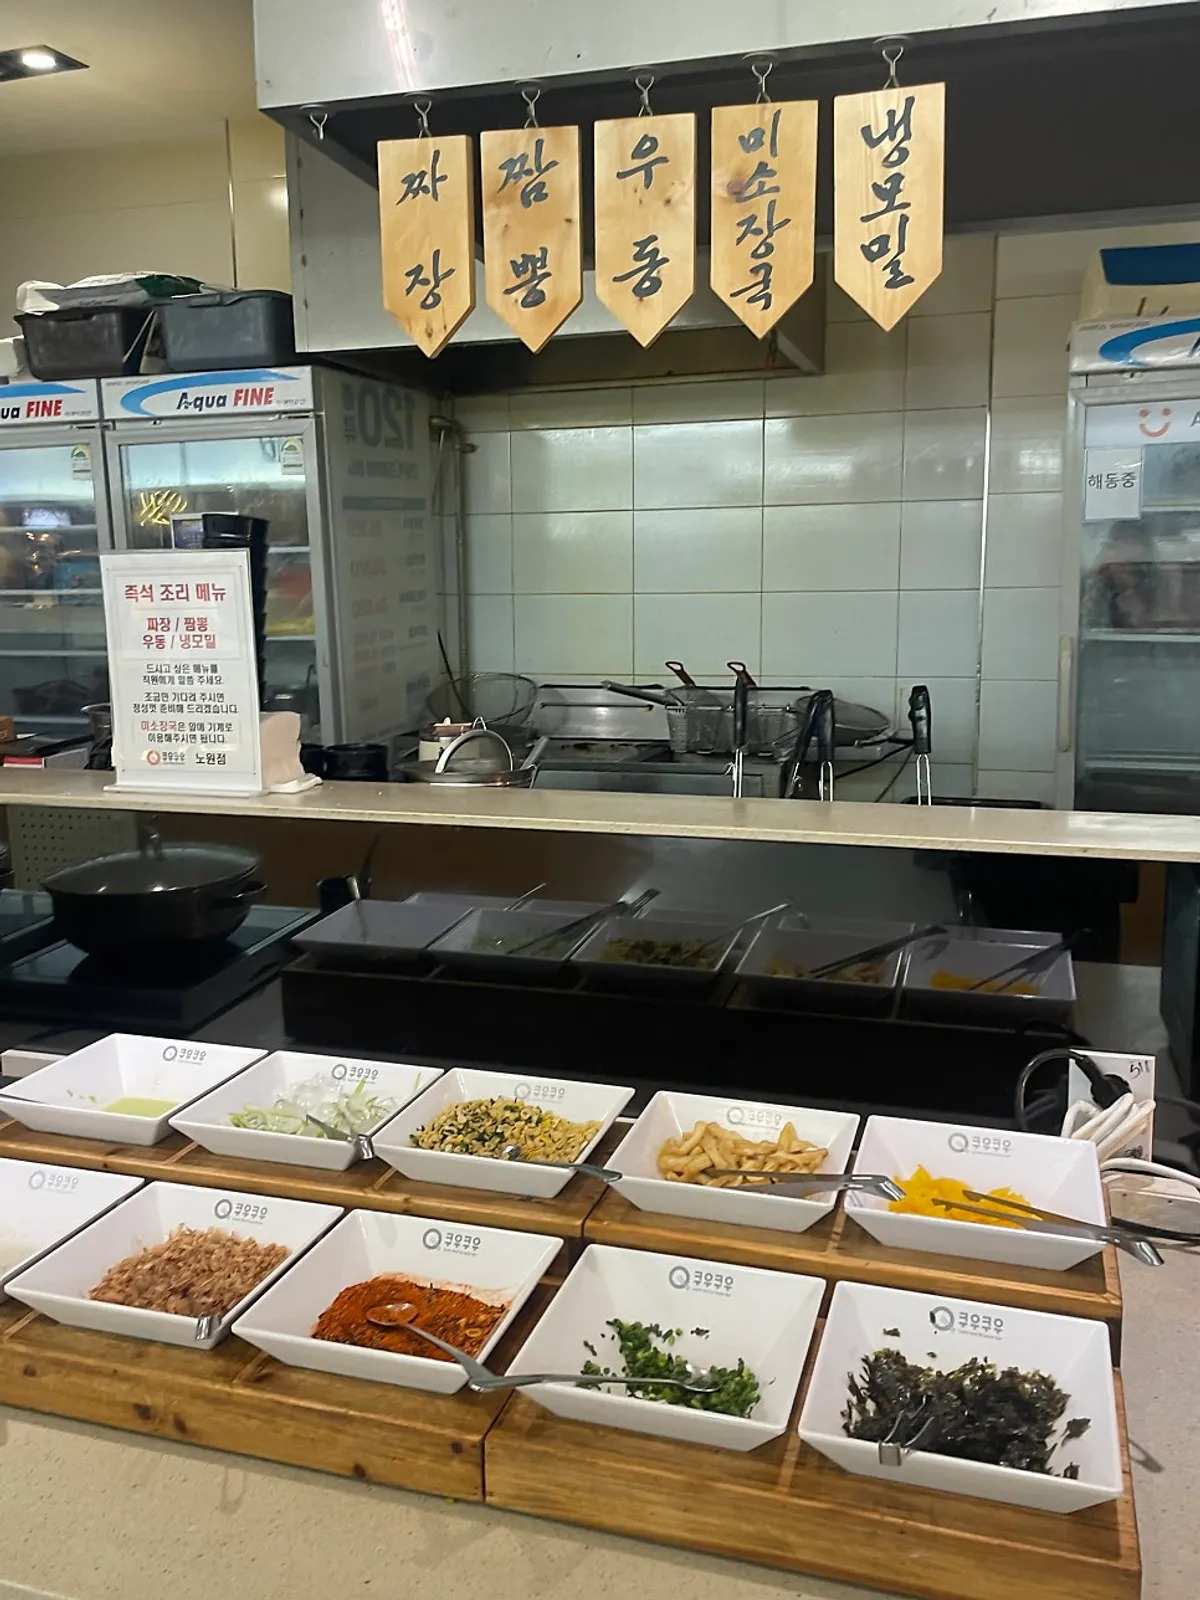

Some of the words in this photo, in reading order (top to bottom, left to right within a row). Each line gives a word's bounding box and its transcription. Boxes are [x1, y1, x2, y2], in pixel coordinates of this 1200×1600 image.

[860, 96, 915, 290] 냉모밀
[613, 133, 671, 299] 우동
[729, 110, 791, 312] 미소장국
[396, 150, 456, 309] 짜장
[497, 139, 560, 308] 짬뽕
[26, 399, 63, 417] FINE
[176, 391, 227, 412] Aqua
[232, 387, 274, 407] FINE
[1088, 471, 1138, 490] 해동중
[124, 583, 154, 603] 즉석
[160, 583, 190, 602] 조리
[196, 583, 226, 602] 메뉴
[142, 635, 166, 650] 우동
[179, 634, 217, 649] 냉모밀
[146, 664, 171, 675] 드시고
[193, 664, 218, 674] 메뉴를
[142, 676, 175, 686] 직원에게
[144, 692, 169, 703] 조금만
[172, 692, 196, 703] 기다려
[199, 692, 225, 703] 주시면
[160, 704, 184, 714] 준비해
[140, 720, 186, 732] 미소장국은
[207, 721, 234, 732] 기계로
[147, 733, 197, 744] 이용해주시면
[195, 752, 226, 765] 노원점
[179, 1047, 206, 1062] 쿠우쿠우
[349, 1066, 378, 1081] 쿠우쿠우
[972, 1135, 1012, 1152] 쿠우쿠우
[234, 1203, 268, 1221] 쿠우쿠우
[445, 1232, 481, 1252] 쿠우쿠우
[693, 1270, 734, 1291] 쿠우쿠우
[958, 1311, 1004, 1334] 쿠우쿠우
